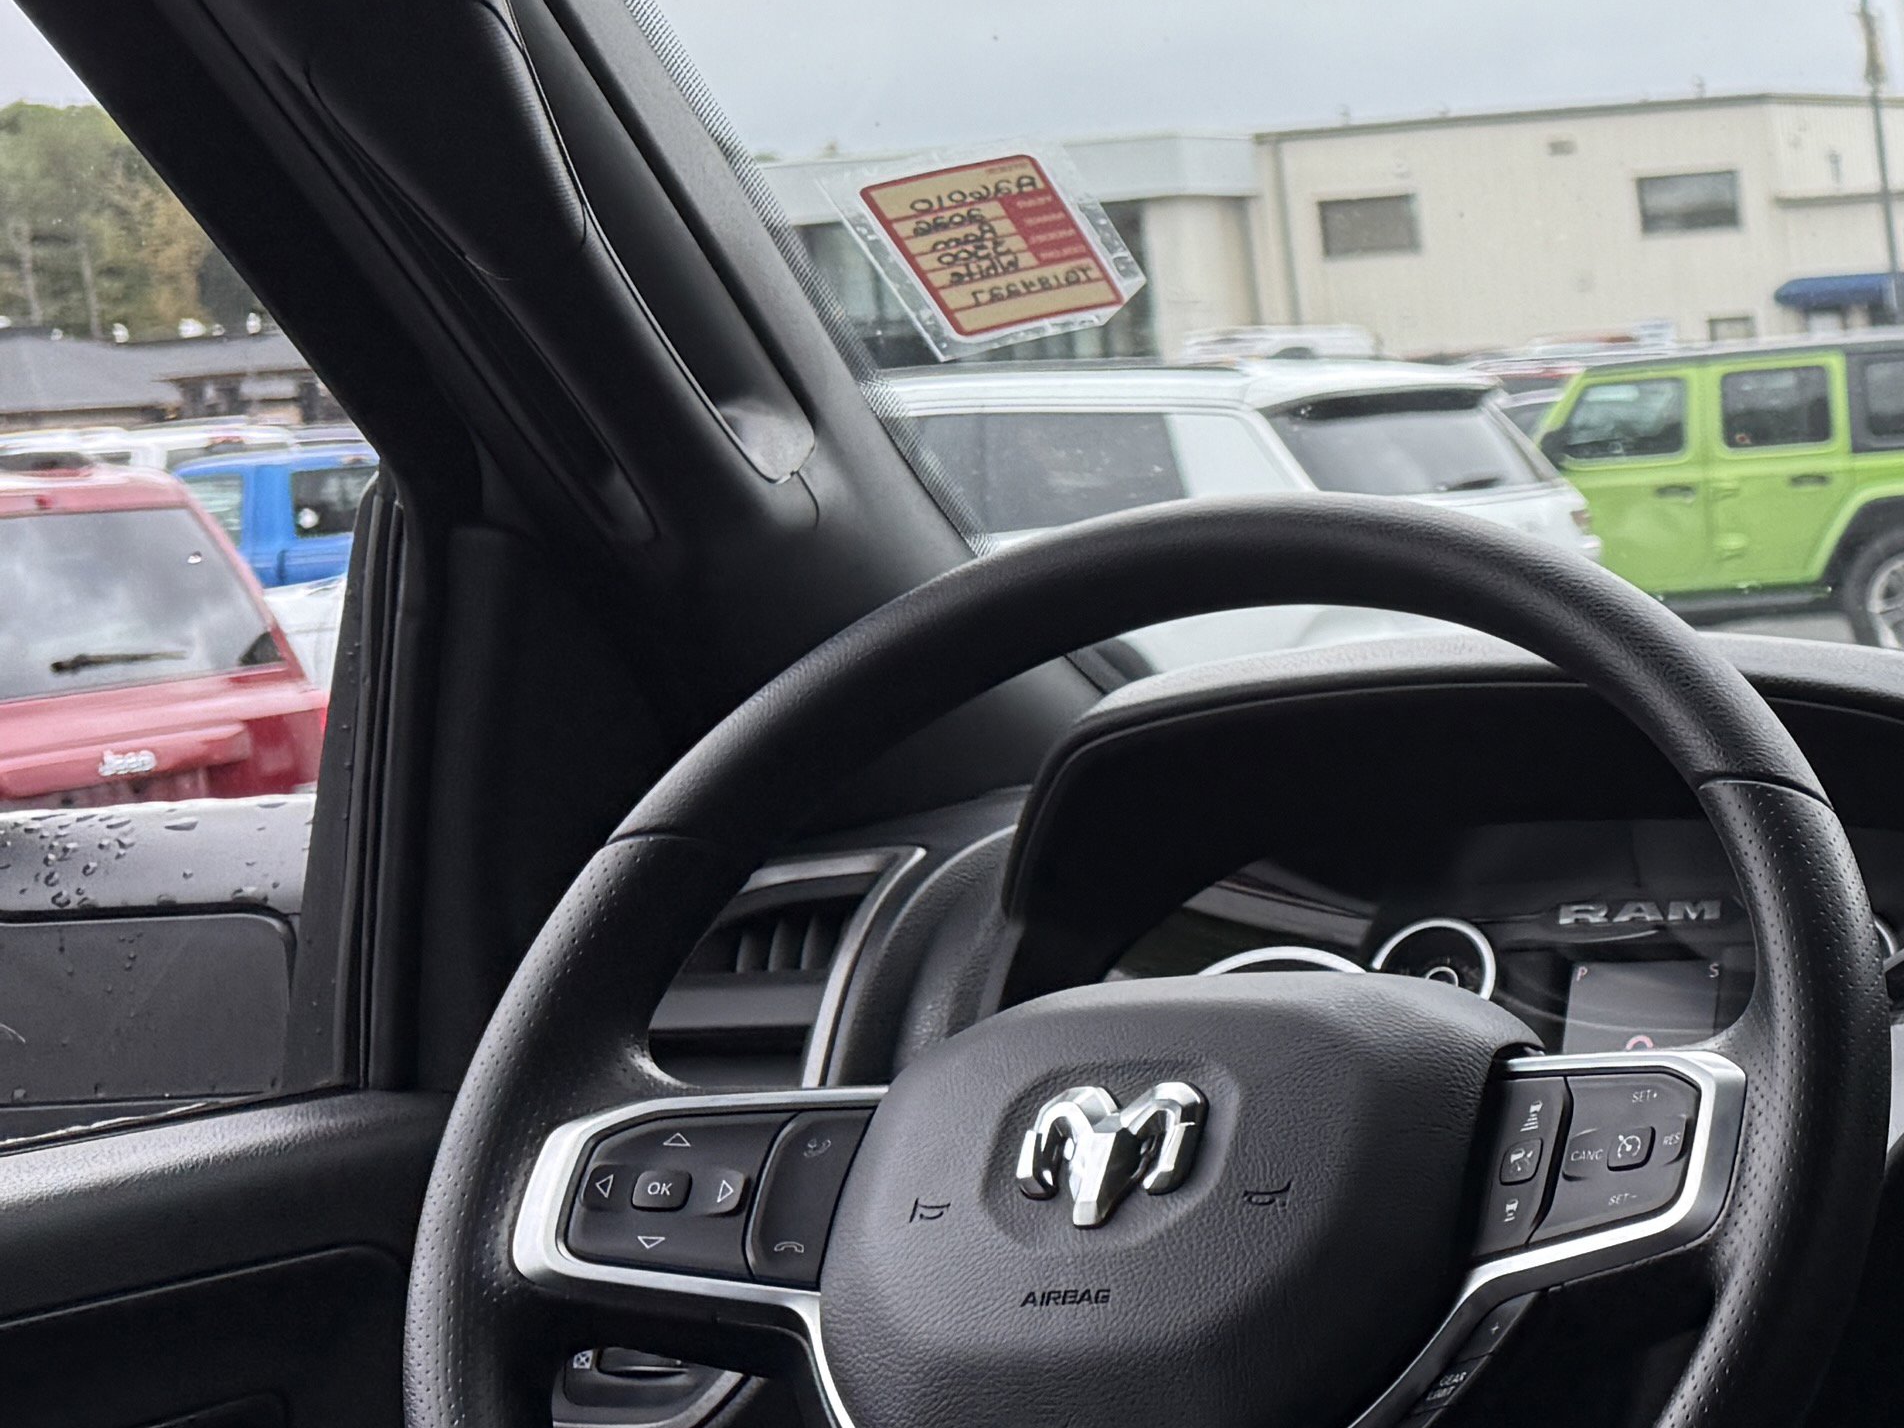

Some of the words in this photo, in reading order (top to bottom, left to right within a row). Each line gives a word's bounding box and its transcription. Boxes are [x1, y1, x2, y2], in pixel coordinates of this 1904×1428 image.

[1558, 900, 1722, 926] RAM
[1576, 965, 1588, 982] P
[1569, 1148, 1605, 1162] CANC
[647, 1181, 673, 1196] OK
[1019, 1288, 1111, 1308] AIRBAG
